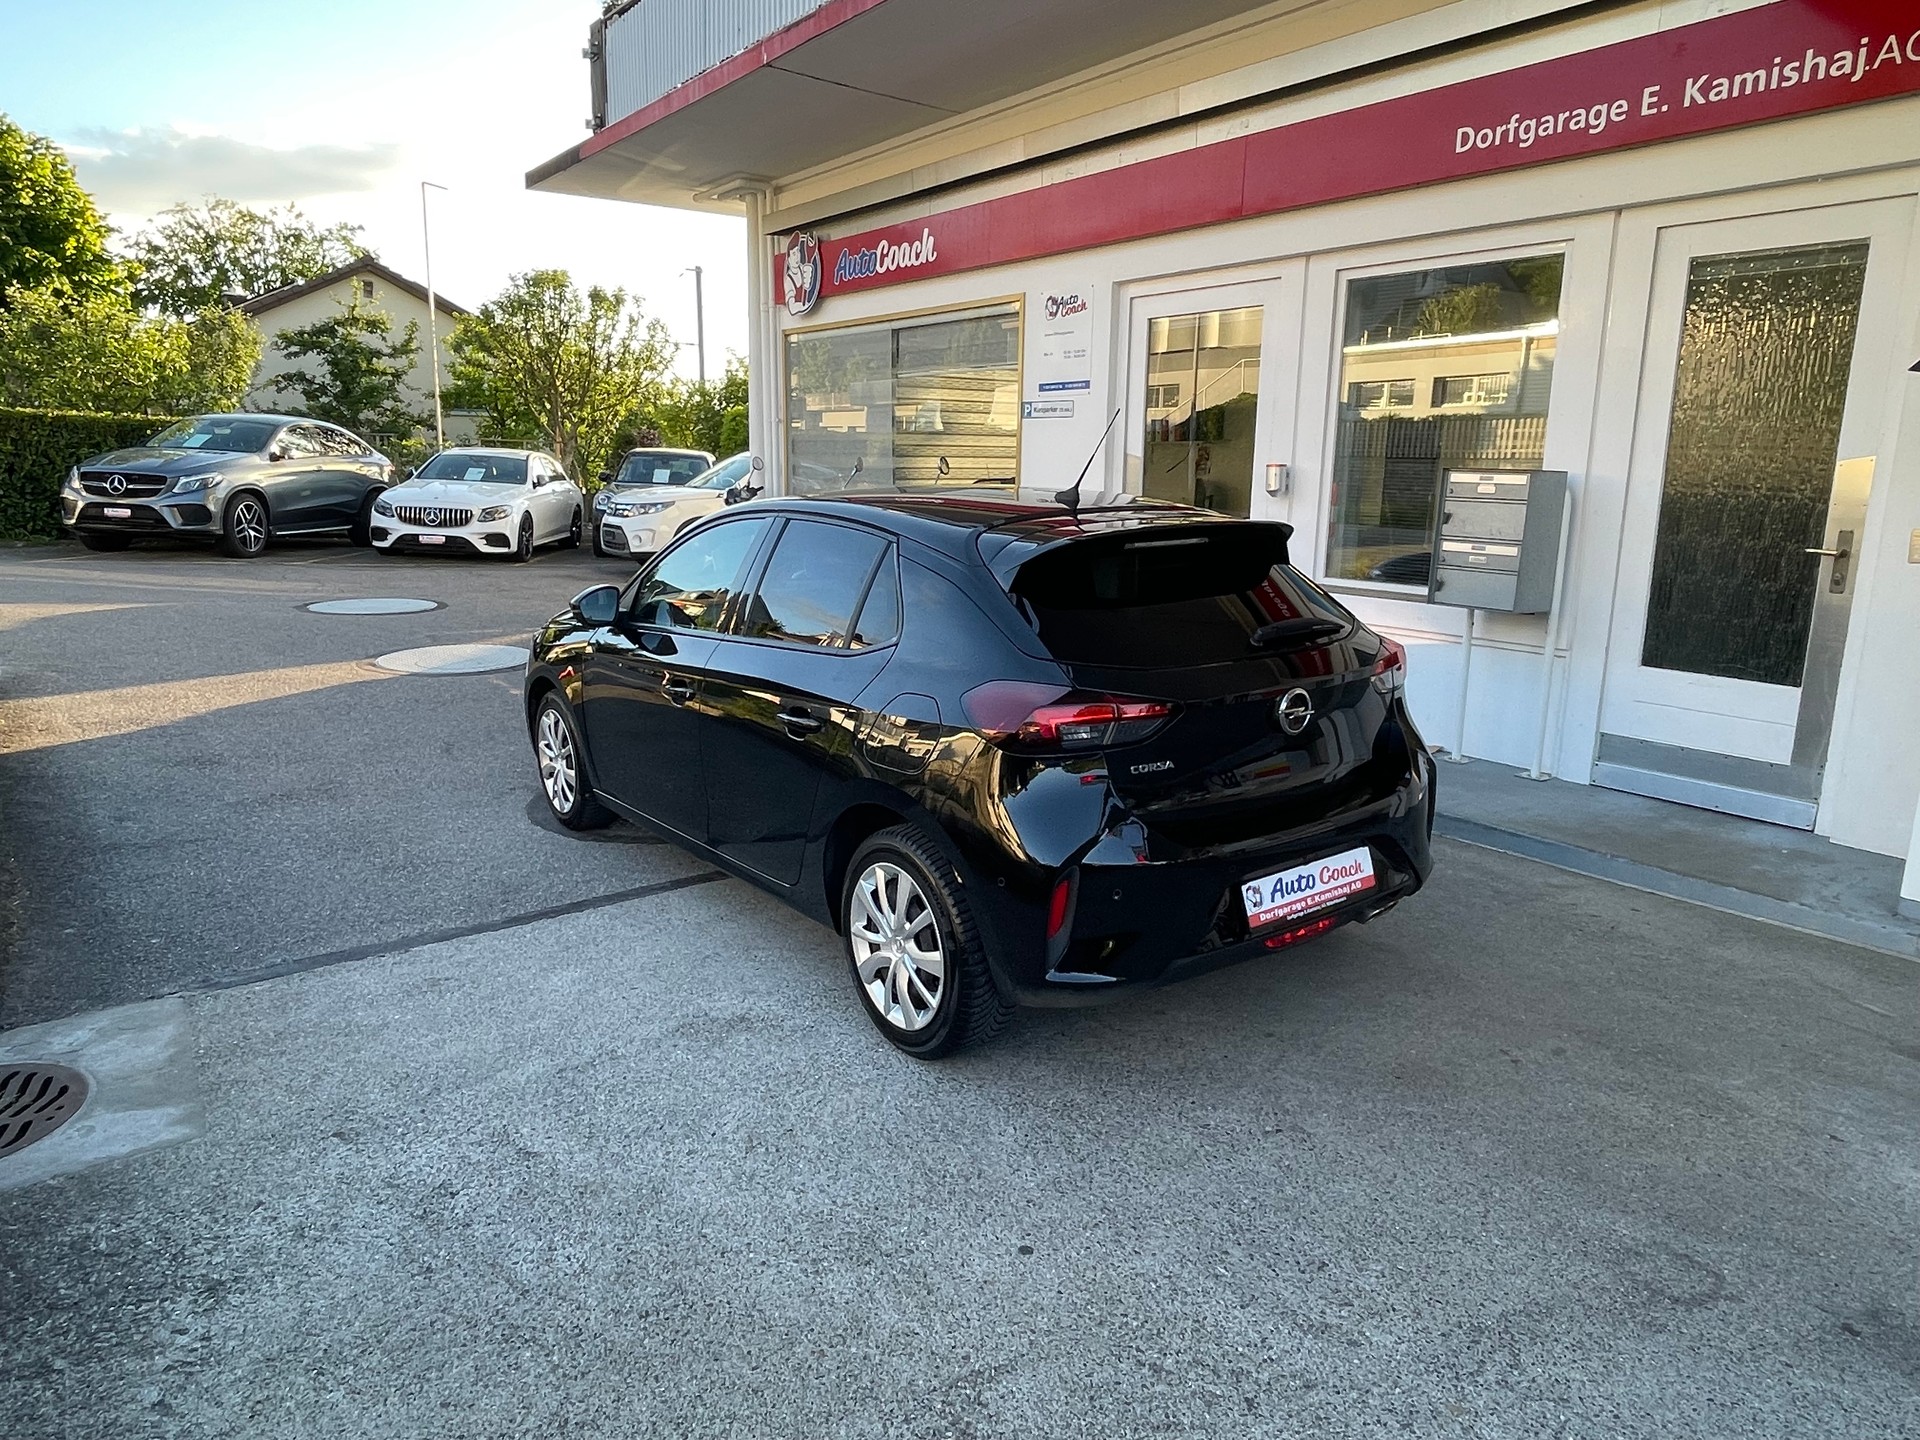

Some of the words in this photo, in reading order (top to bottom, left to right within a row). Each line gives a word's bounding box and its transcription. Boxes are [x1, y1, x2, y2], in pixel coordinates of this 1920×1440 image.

[1454, 98, 1629, 154] Dorfgarage
[1640, 84, 1669, 117] E.
[1059, 294, 1079, 307] Auto
[1061, 299, 1088, 318] Coach
[1024, 403, 1032, 417] P
[1130, 760, 1175, 775] CORSA
[1270, 873, 1316, 903] Auto
[1319, 859, 1365, 885] Coach
[1259, 901, 1306, 921] Dorfgarage
